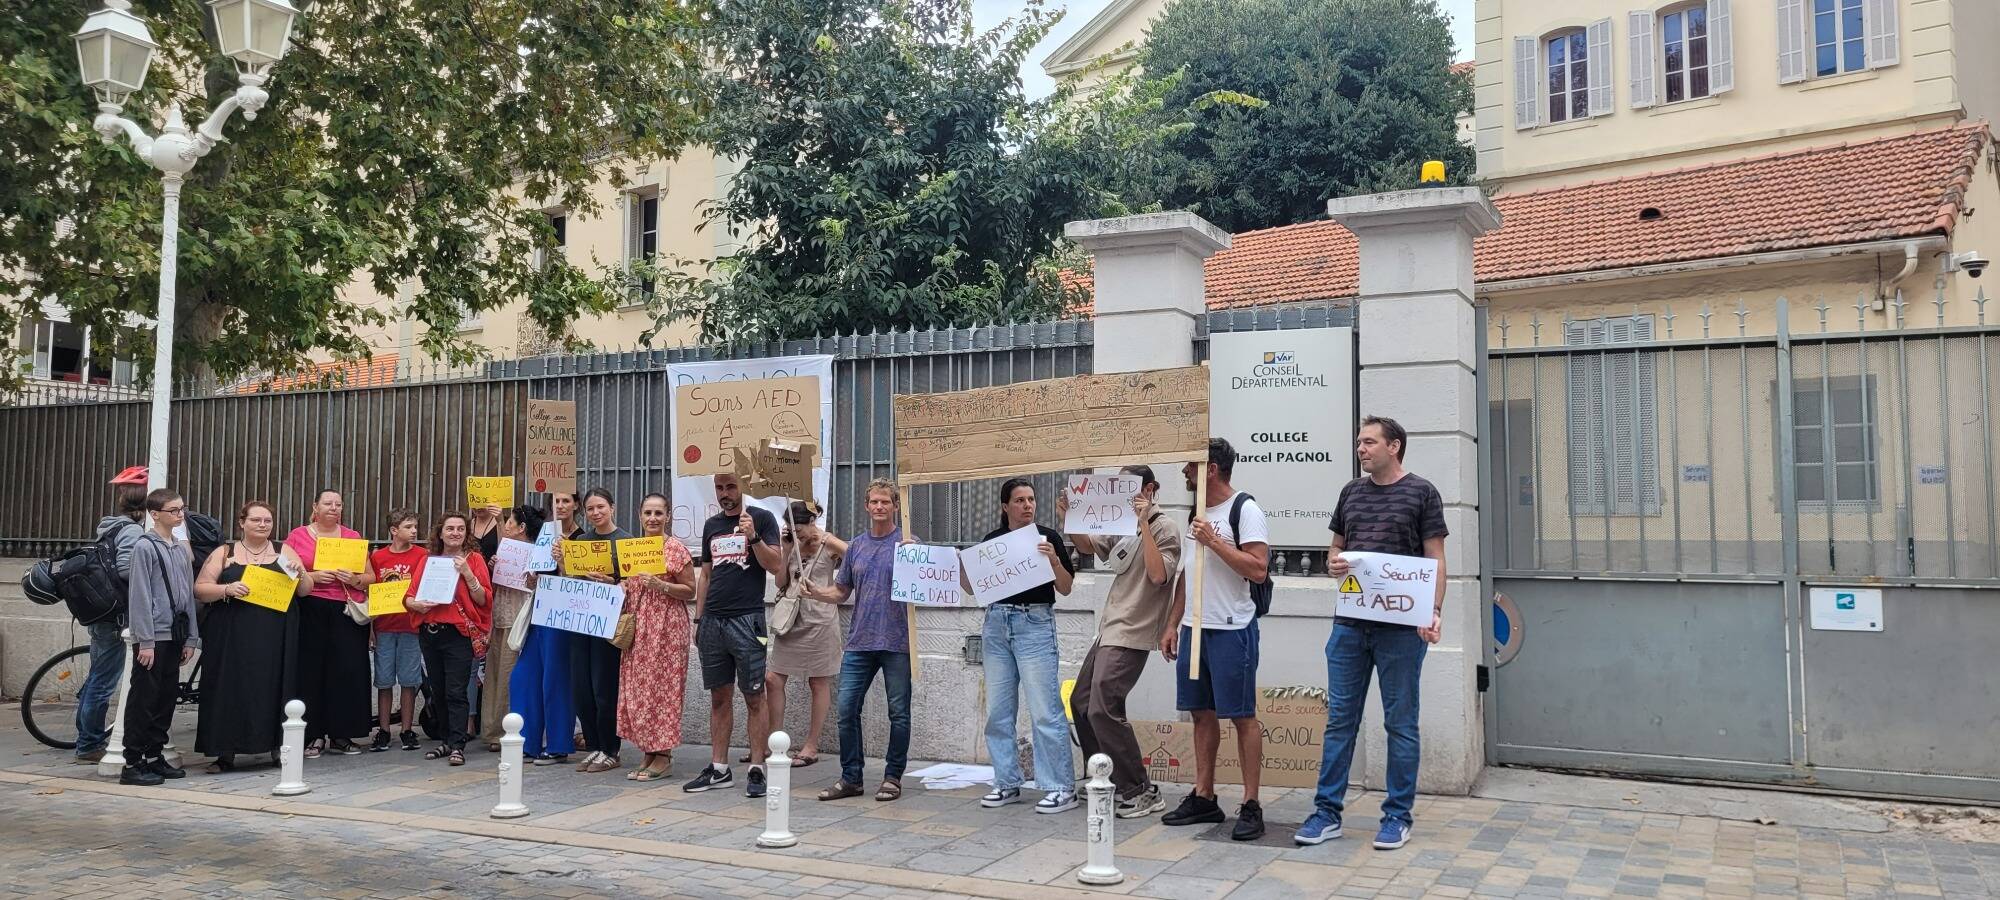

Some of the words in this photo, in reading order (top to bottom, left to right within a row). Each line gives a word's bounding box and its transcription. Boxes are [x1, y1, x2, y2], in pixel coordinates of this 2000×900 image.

[690, 387, 743, 416] Sans
[752, 389, 802, 409] AED
[1251, 432, 1309, 443] COLLEGE
[551, 445, 564, 456] PAS
[1276, 452, 1333, 462] PAGNOL
[1069, 477, 1138, 496] WANTED
[1083, 504, 1123, 522] AED
[565, 545, 588, 559] AED
[897, 546, 936, 565] PAGNOL
[979, 542, 1008, 565] AED
[919, 565, 957, 582] SOUDÉ
[1380, 563, 1433, 583] Sécurité
[540, 577, 552, 591] UNE
[560, 578, 611, 601] DOTATION
[929, 587, 960, 604] D'AED
[569, 598, 591, 610] SANS
[545, 608, 608, 637] AMBITION
[1266, 697, 1291, 714] des
[1156, 724, 1173, 734] AED
